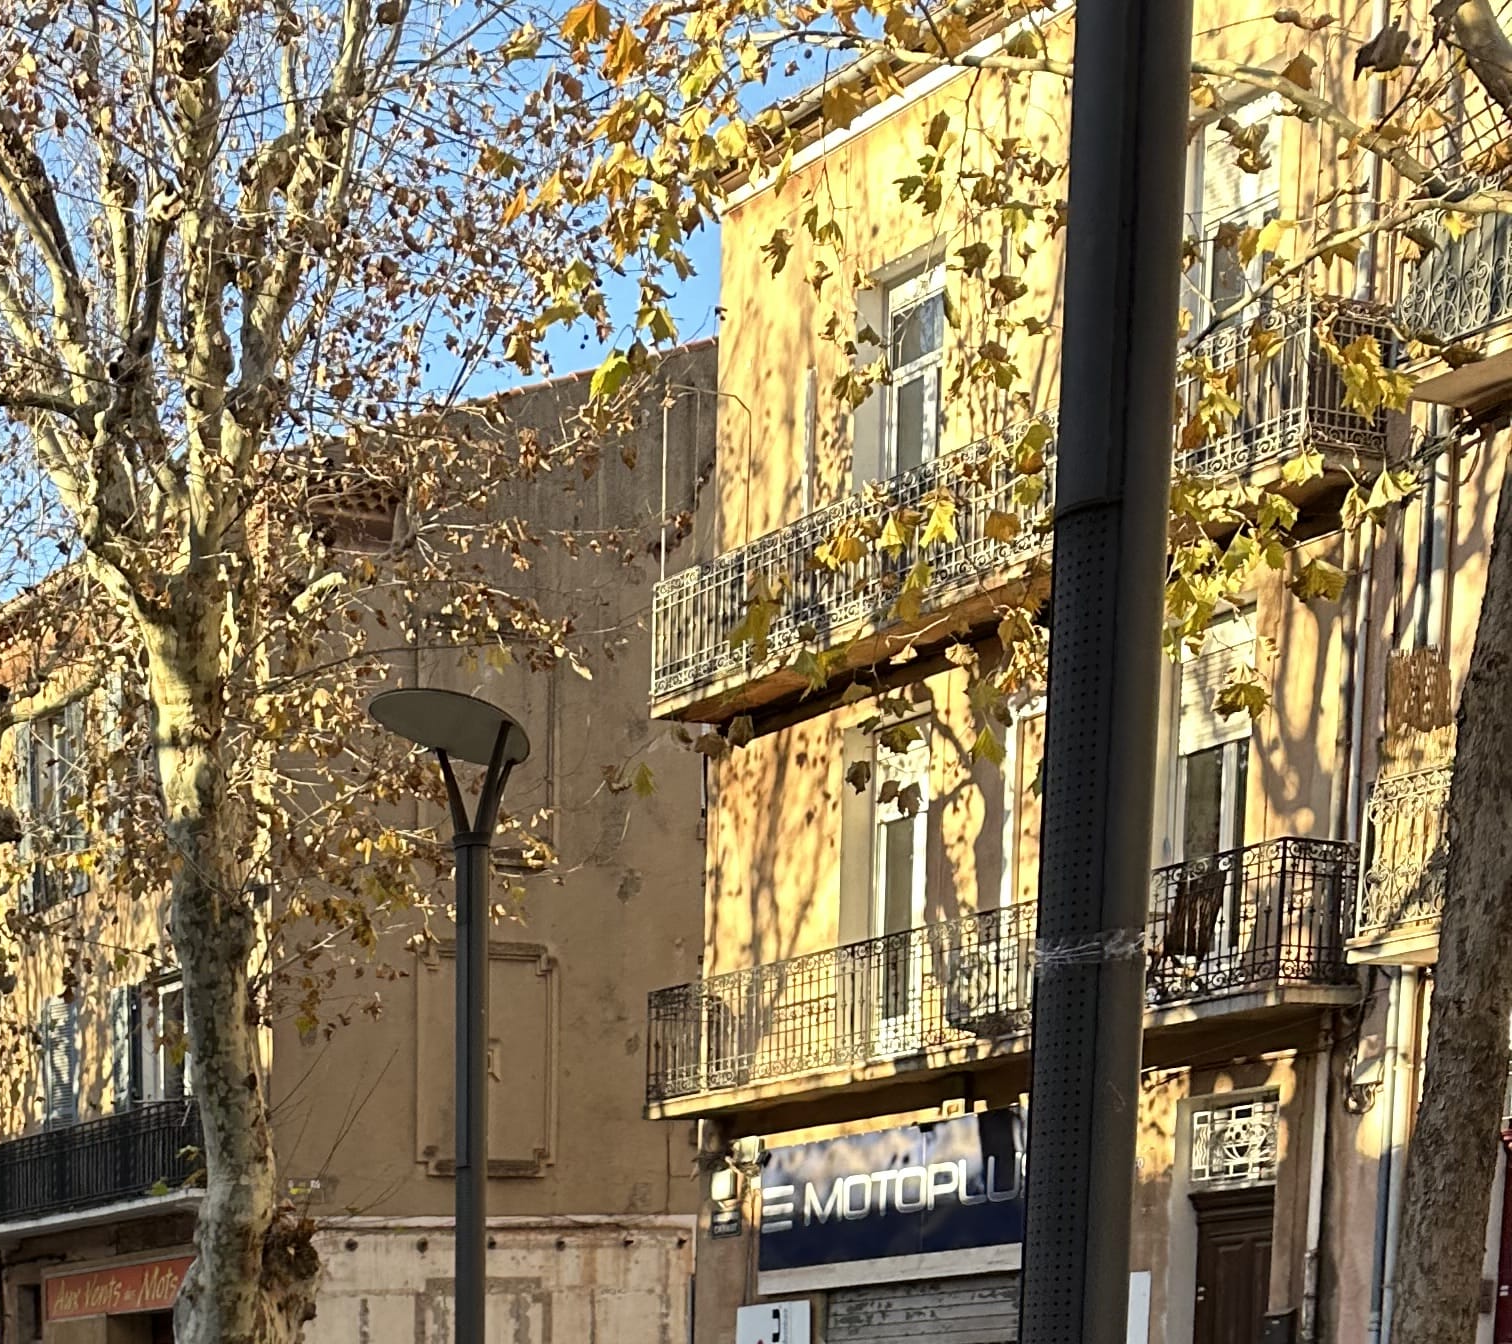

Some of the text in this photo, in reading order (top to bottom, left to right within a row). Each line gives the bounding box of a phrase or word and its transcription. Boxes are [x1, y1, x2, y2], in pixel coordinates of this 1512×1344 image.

[803, 1149, 1026, 1227] MOTOPLU
[52, 1279, 81, 1315] Aux
[84, 1273, 123, 1308] Vents
[137, 1265, 180, 1307] Mots
